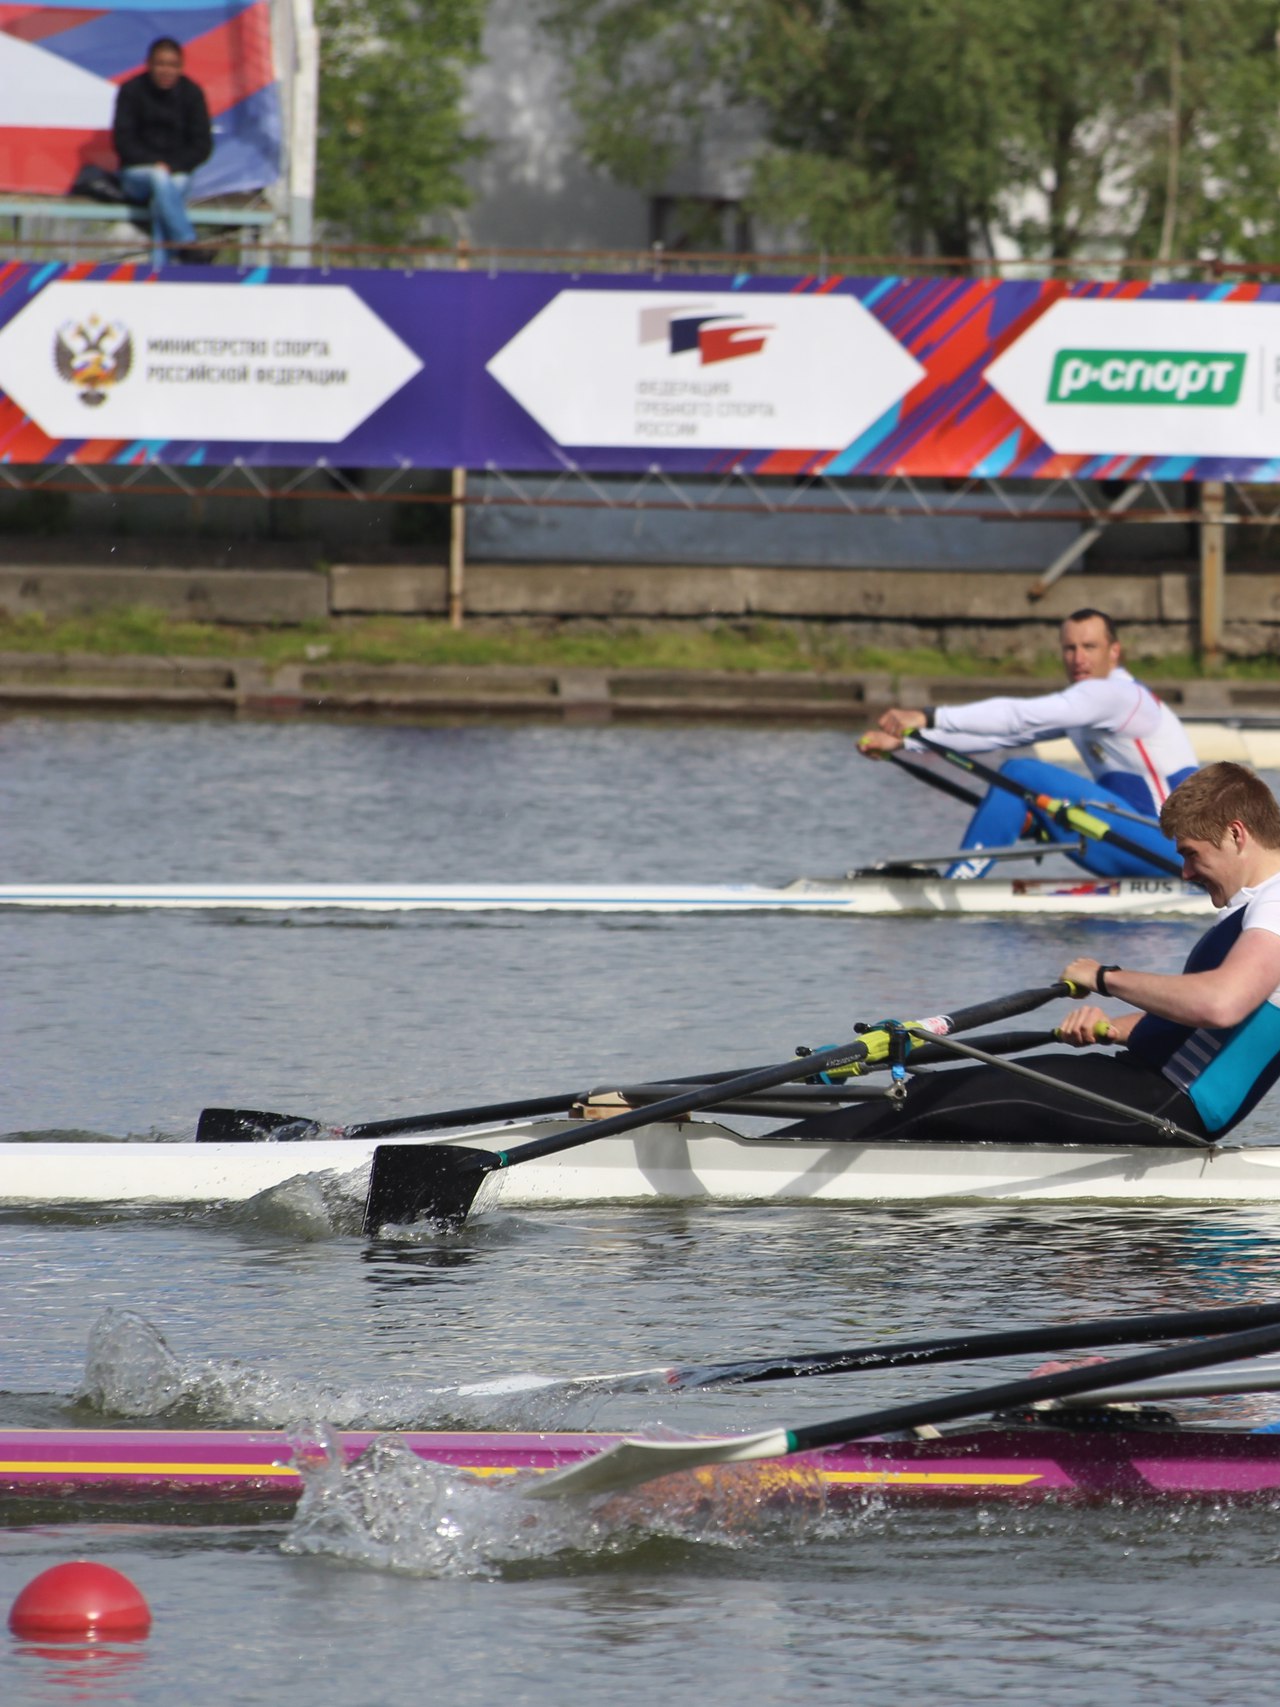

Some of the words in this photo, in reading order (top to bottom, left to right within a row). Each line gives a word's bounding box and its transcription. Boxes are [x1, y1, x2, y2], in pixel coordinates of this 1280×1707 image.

[147, 338, 267, 356] МИНИСТЕРСТВО
[273, 340, 330, 357] СПОРТА
[147, 364, 249, 383] РОССИЙСКОЙ
[256, 367, 348, 385] ФЕДЕРАЦИИ
[636, 380, 731, 397] ФЕДЕРАЦИЯ
[635, 401, 713, 417] ГРЕБНОГО
[717, 402, 776, 418] СПОРТА
[635, 421, 698, 437] РОССИИ
[1129, 881, 1173, 894] RUS
